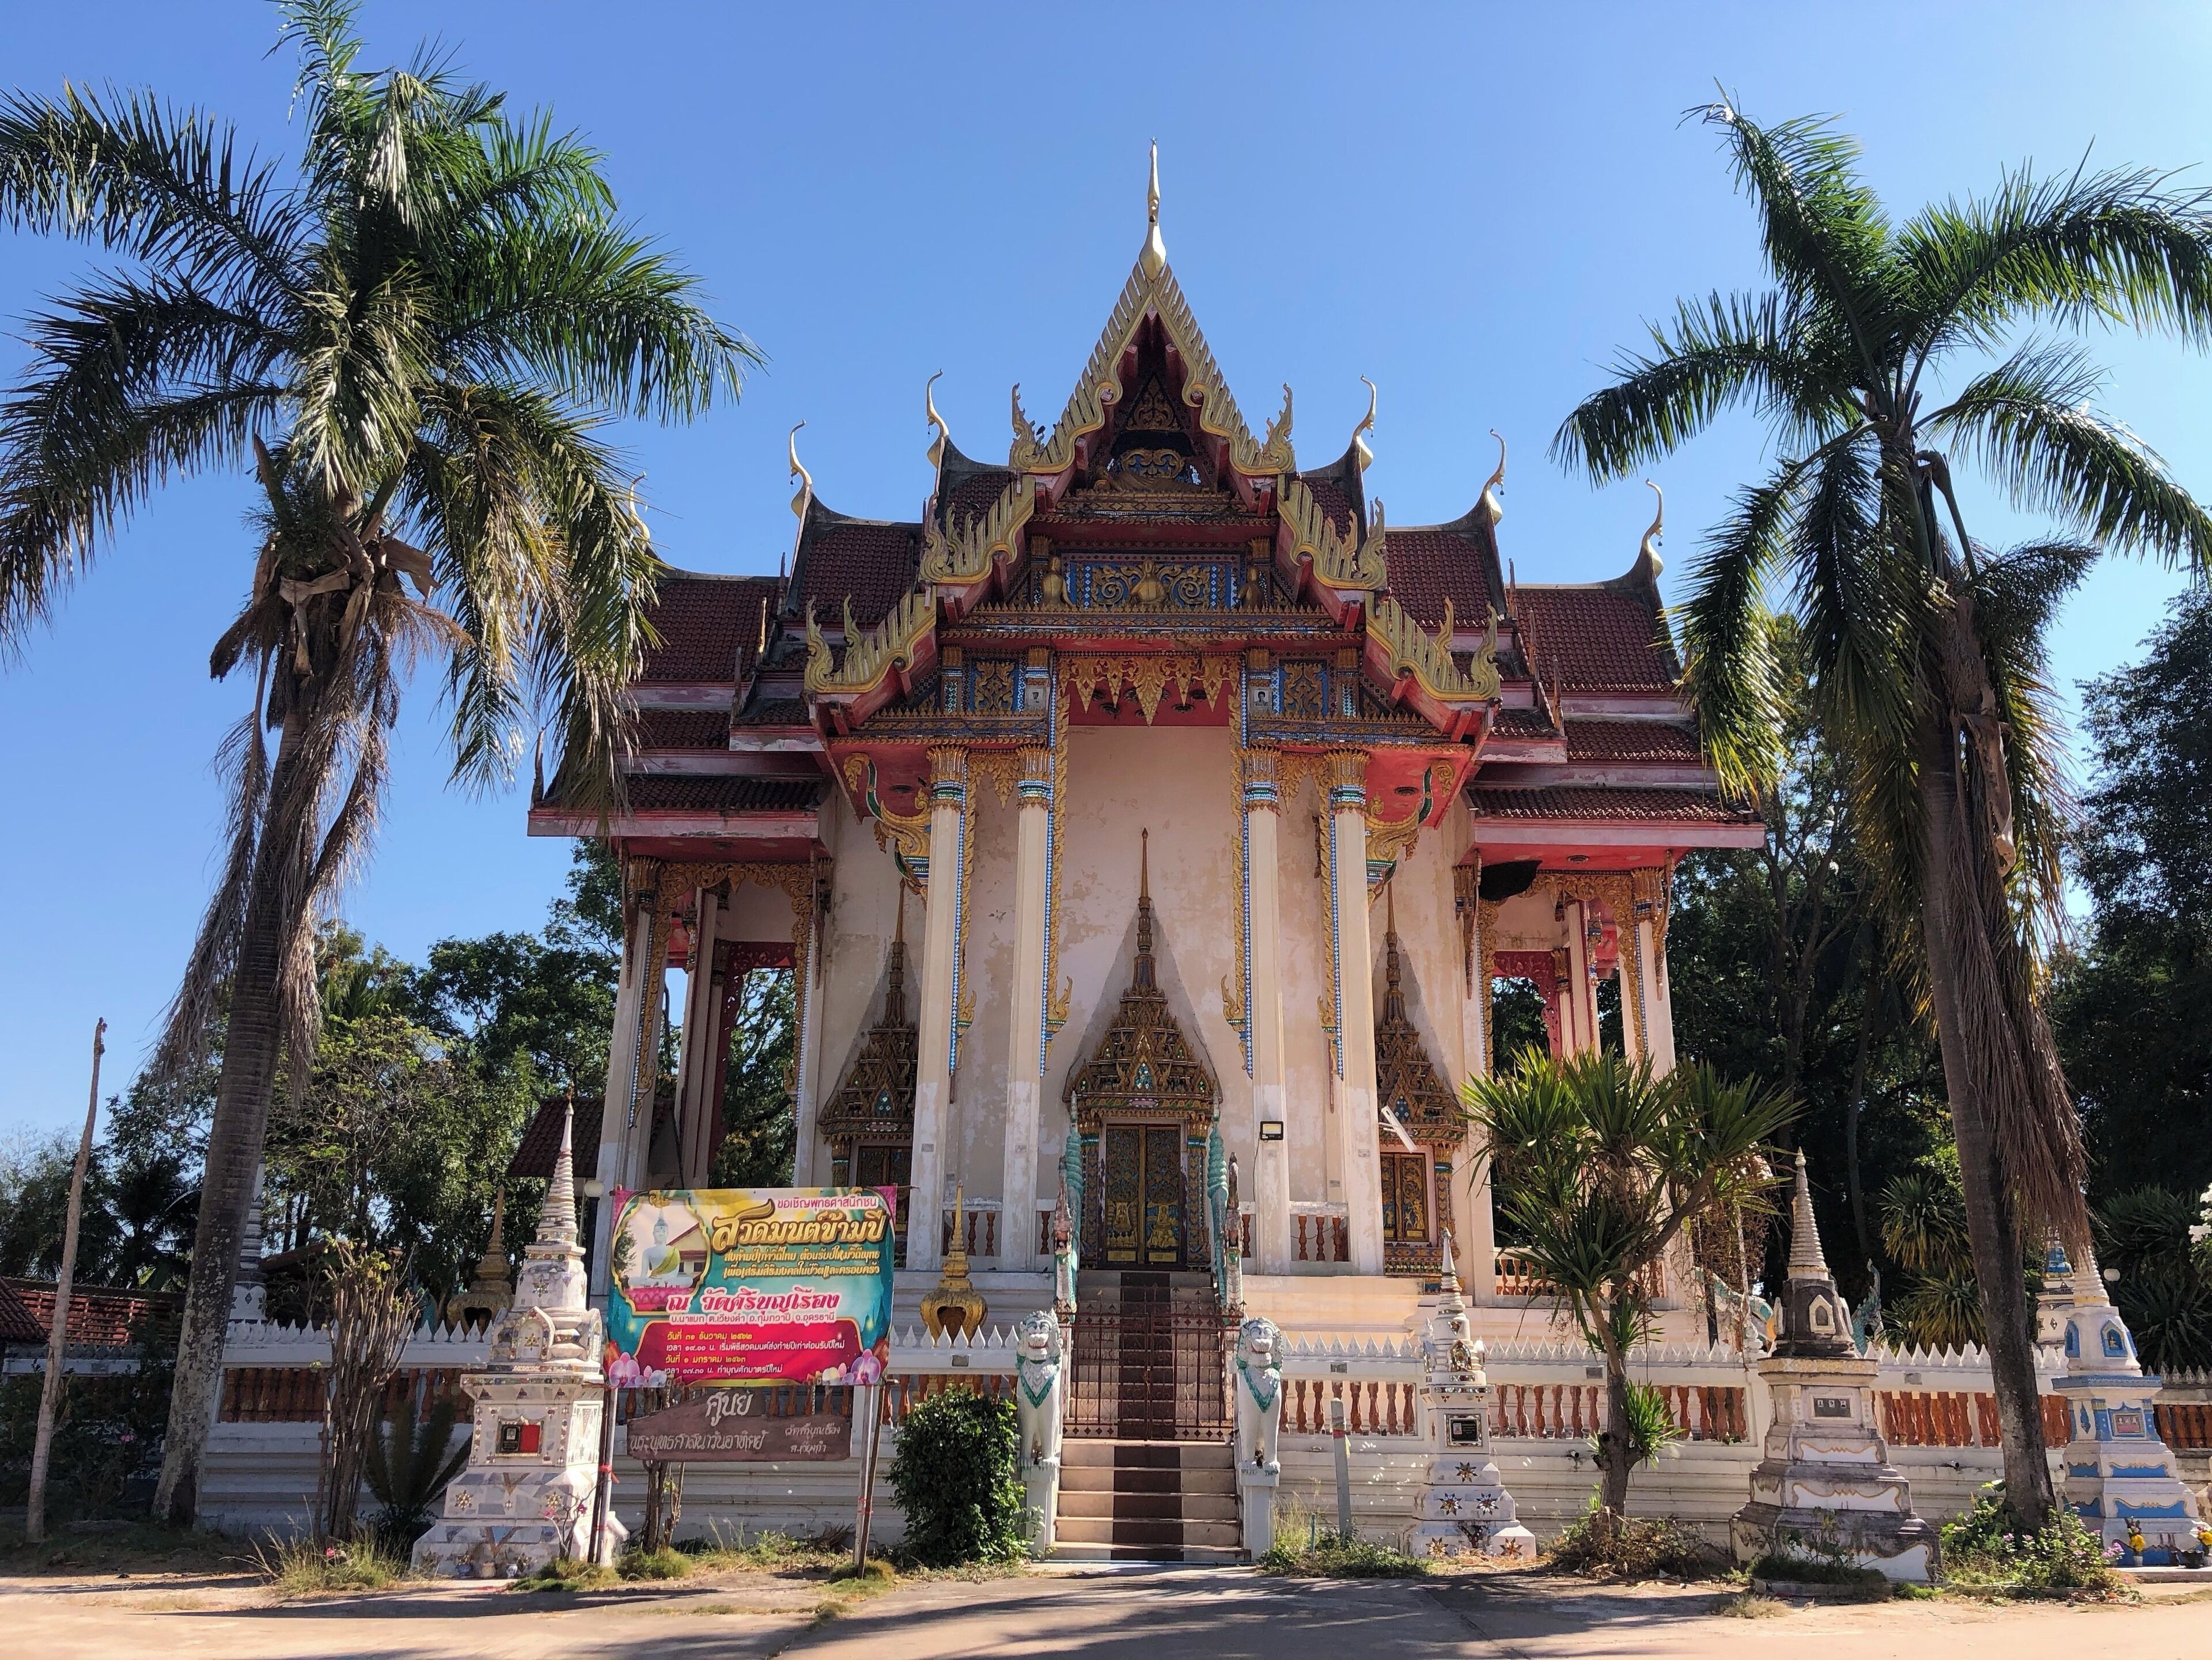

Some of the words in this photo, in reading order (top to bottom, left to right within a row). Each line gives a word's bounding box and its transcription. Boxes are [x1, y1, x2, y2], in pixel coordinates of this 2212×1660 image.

[778, 1196, 877, 1211] ขอเชิญพุทธศาสนิกชน
[713, 1198, 887, 1251] สวดมนต์ข้ามปี
[668, 1295, 691, 1311] ณ
[702, 1287, 840, 1314] วัดศรีบุญเรือง
[796, 1311, 835, 1324] จ.อุดรธานี
[667, 1329, 682, 1340] วันที่
[699, 1331, 727, 1340] ธันวาคม
[665, 1352, 681, 1363] วันที่
[717, 1363, 783, 1375] ทำบุญตักบาตรปีใหม่
[705, 1389, 754, 1427] ศูนย์
